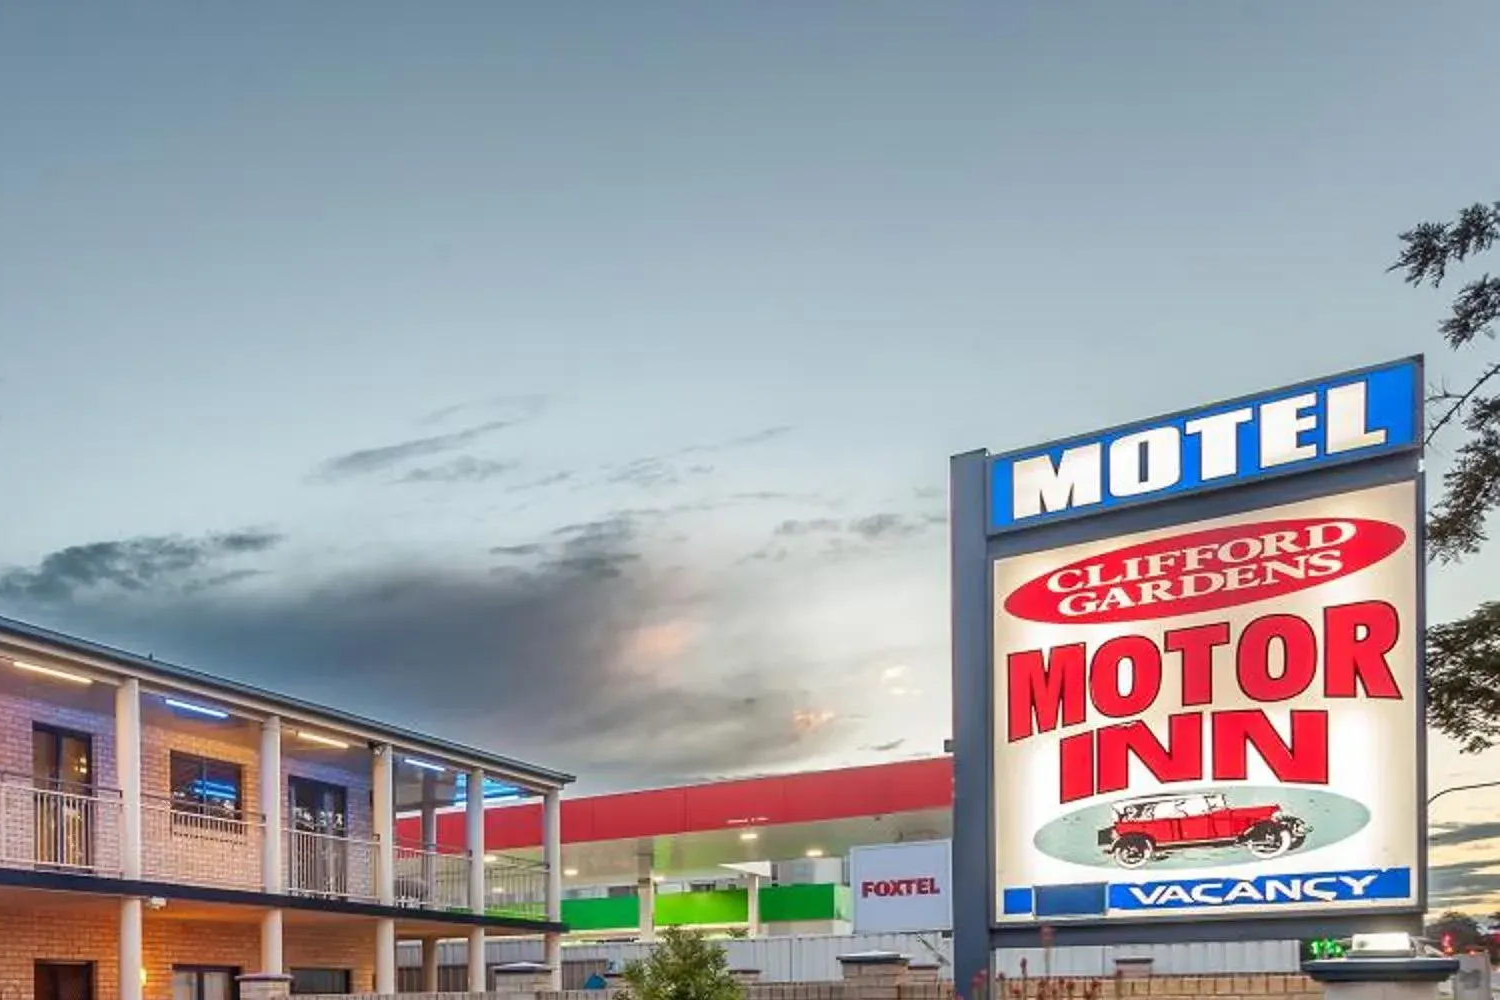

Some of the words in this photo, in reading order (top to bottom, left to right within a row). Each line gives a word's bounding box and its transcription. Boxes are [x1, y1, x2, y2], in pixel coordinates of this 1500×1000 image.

[1013, 379, 1388, 520] MOTEL
[1046, 520, 1357, 594] CLIFFORD
[1056, 549, 1344, 616] GARDENS
[1006, 599, 1404, 743] MOTOR
[1058, 709, 1329, 805] INN
[861, 877, 941, 898] FOXTEL
[1128, 874, 1379, 906] VACANCY
